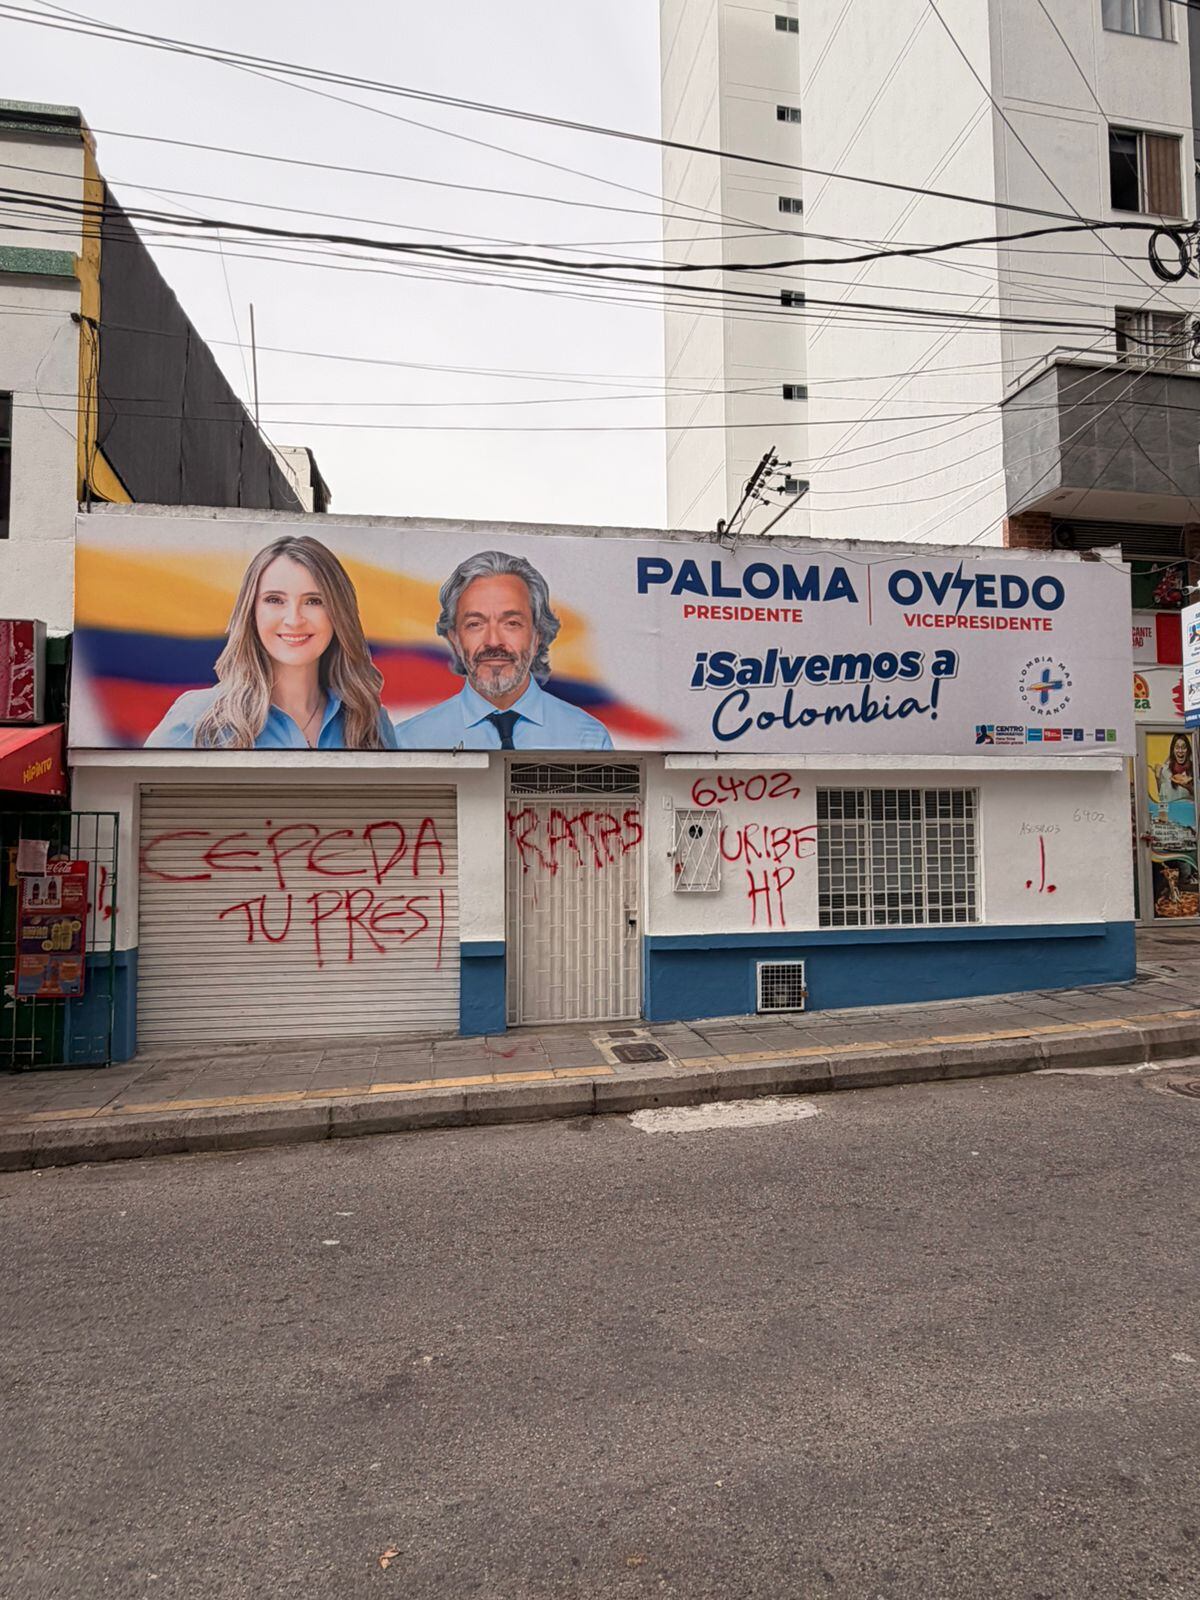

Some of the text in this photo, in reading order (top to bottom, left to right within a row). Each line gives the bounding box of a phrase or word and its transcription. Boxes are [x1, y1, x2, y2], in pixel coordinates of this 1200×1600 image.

[636, 557, 858, 603] PALOMA
[888, 560, 1065, 615] OVIEDO
[683, 605, 803, 623] PRESIDENTE
[903, 612, 1053, 632] VICEPRESIDENTE
[691, 649, 957, 688] ¡Salvemos a
[1019, 656, 1053, 701] COLOMBIA
[712, 679, 940, 743] Colombia!
[1030, 696, 1071, 715] GRANDE
[691, 772, 801, 807] 6402
[140, 818, 446, 889] CEPEDA
[720, 823, 826, 865] URIBE
[746, 866, 796, 927] HP
[218, 889, 445, 969] TU PRESI
